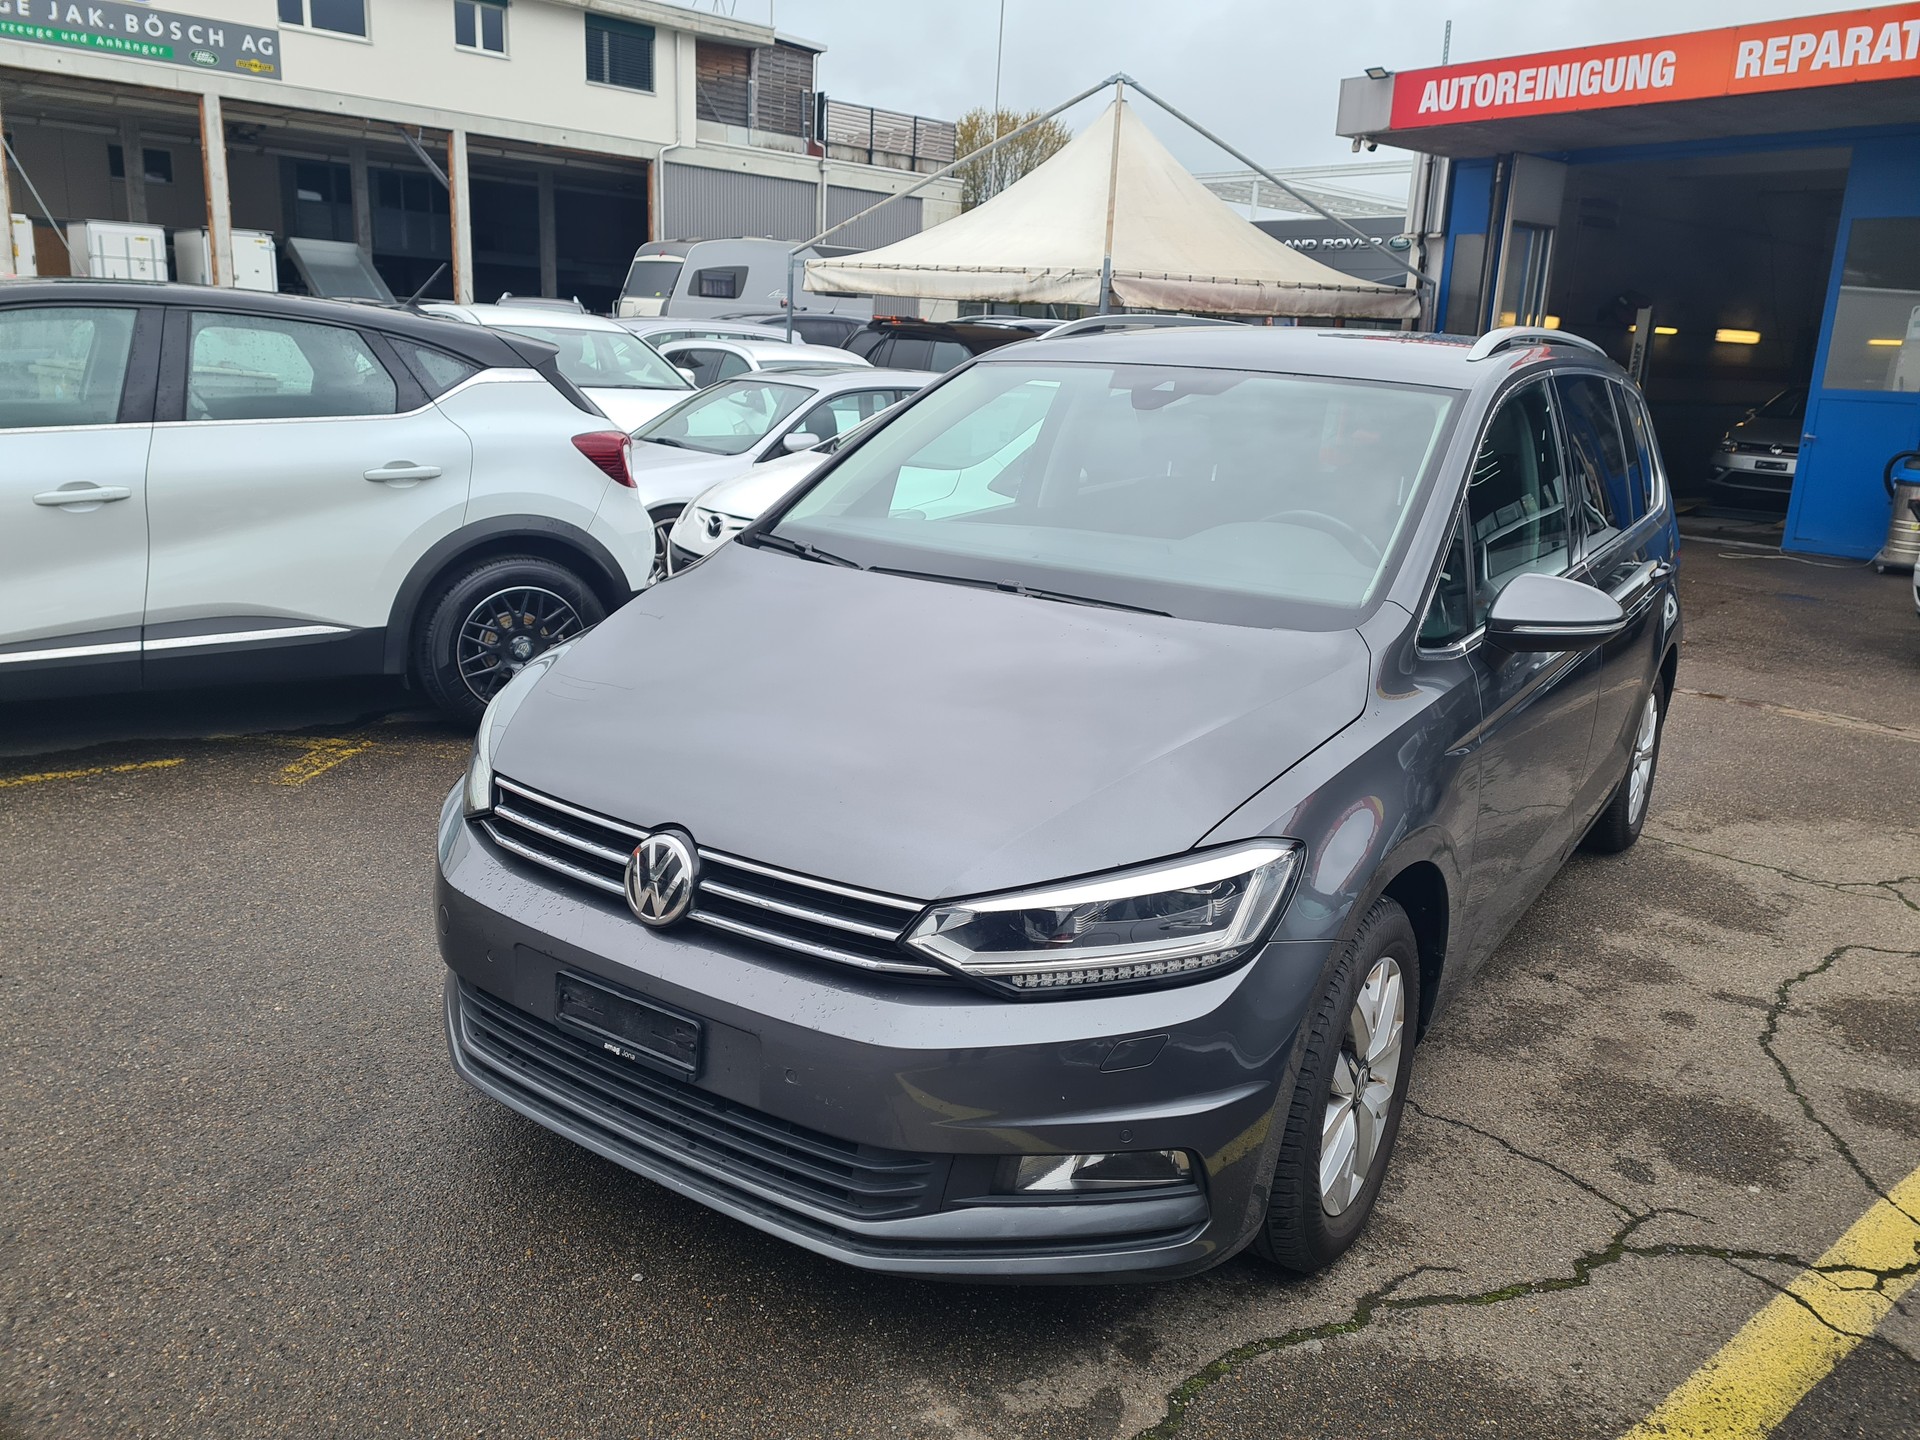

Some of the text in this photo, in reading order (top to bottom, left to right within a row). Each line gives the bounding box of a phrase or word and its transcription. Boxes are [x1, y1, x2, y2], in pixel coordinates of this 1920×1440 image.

[48, 1, 115, 29] JAK.
[125, 13, 224, 47] BÖSCH
[241, 34, 274, 56] AG
[61, 32, 88, 43] und
[96, 36, 165, 55] Anhänger
[1735, 19, 1920, 79] REPARAT
[1418, 50, 1676, 114] AUTOREINIGUNG
[1283, 238, 1318, 250] AND
[603, 1042, 636, 1061] amag Jona
